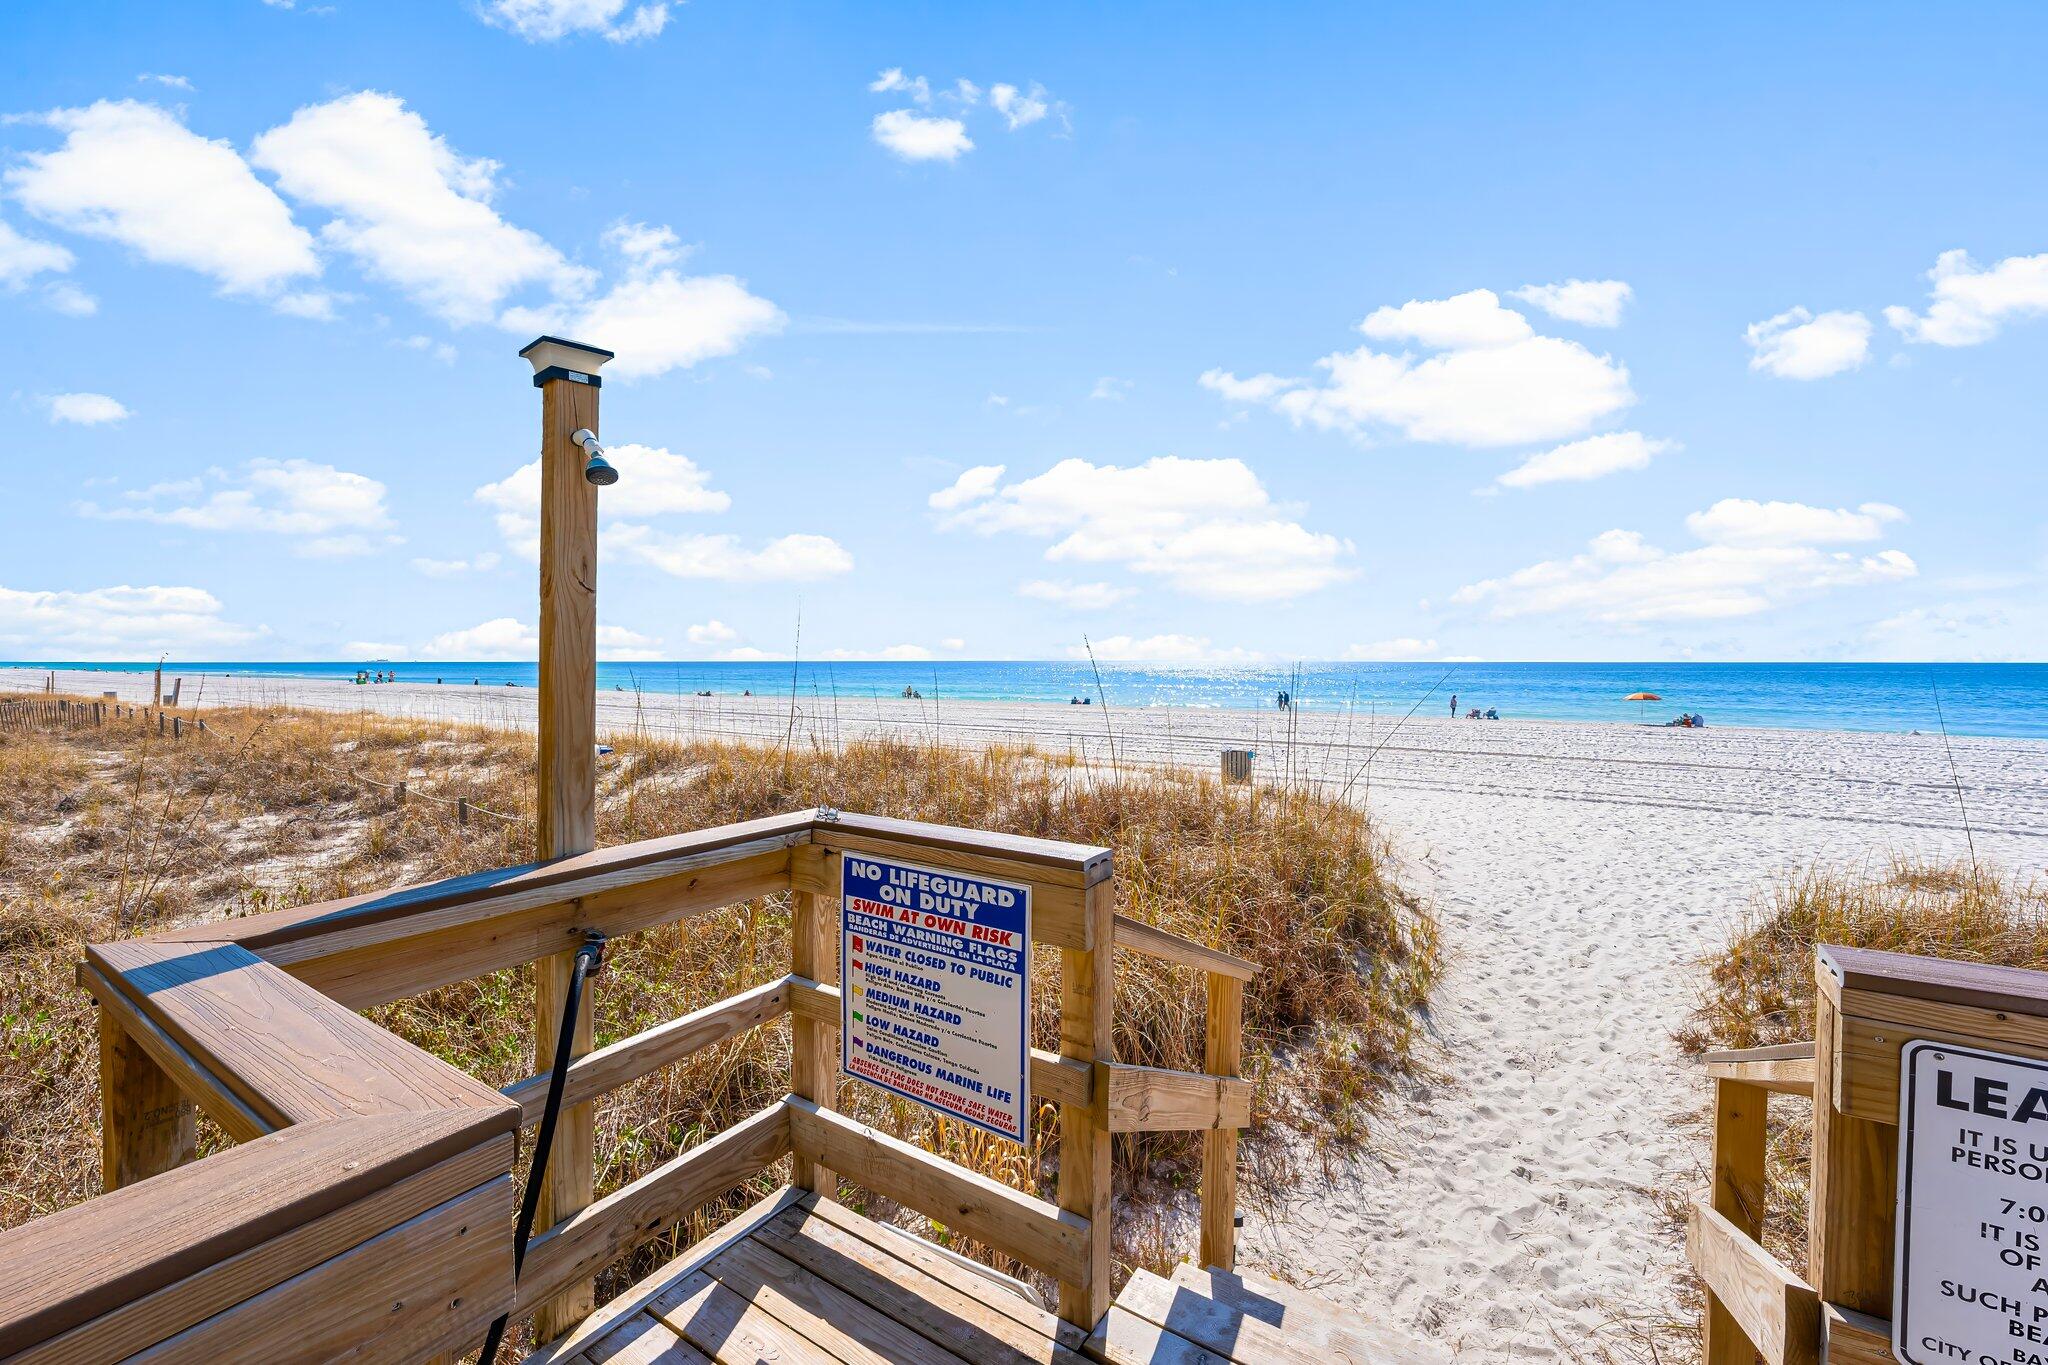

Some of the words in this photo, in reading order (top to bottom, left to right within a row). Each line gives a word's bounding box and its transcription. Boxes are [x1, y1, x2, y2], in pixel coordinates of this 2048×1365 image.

[852, 861, 881, 880] NO
[890, 868, 1015, 908] LIFEGUARD
[880, 885, 910, 905] ON
[920, 893, 979, 919] DUTY
[848, 913, 887, 931] BEACH
[893, 923, 963, 949] WARNING
[970, 942, 1017, 963] FLAGS
[853, 899, 893, 918] SWIM
[899, 909, 919, 924] AT
[925, 915, 966, 935] OWN
[972, 926, 1012, 946] RISK
[849, 924, 887, 938] BANDERAS
[902, 936, 955, 956] ADVERTENSIA
[959, 951, 970, 959] EN
[972, 954, 983, 963] LA
[987, 958, 1015, 970] PLAYA
[866, 941, 900, 958] WATER
[905, 951, 946, 970] CLOSED
[950, 963, 965, 975] TO
[970, 968, 1012, 988] PUBLIC
[865, 962, 890, 979] HIGH
[894, 973, 940, 992] HAZARD
[907, 984, 923, 994] Strong
[866, 988, 909, 1009] MEDIUM
[914, 1002, 962, 1025] HAZARD
[866, 1015, 890, 1030] LOW
[893, 1024, 939, 1047] HAZARD
[852, 1057, 879, 1072] ABSENCE
[890, 1071, 905, 1082] FLAG
[907, 1077, 924, 1088] DOES
[926, 1084, 939, 1094] NOT
[940, 1090, 966, 1105] ASSURE
[968, 1101, 986, 1112] SAFE
[988, 1108, 1012, 1123] WATER
[866, 1043, 932, 1074] DANGEROUS
[935, 1068, 983, 1094] MARINE
[987, 1086, 1011, 1104] LIFE
[857, 1067, 882, 1080] AUSENCIA
[893, 1080, 923, 1096] BANDERAS
[934, 1097, 962, 1111] ASEGURA
[964, 1108, 985, 1120] AGUAS
[986, 1117, 1017, 1132] SEGURAS
[1960, 1129, 1983, 1147] IT
[1994, 1136, 2017, 1155] IS
[1952, 1147, 2048, 1183] PERSO
[2001, 1198, 2048, 1222] 7:0
[1981, 1222, 2004, 1241] IT
[2016, 1231, 2039, 1251] IS
[2000, 1249, 2040, 1270] OF
[1941, 1280, 2020, 1316] SUCH
[1922, 1337, 1972, 1361] CITY
[2013, 1348, 2048, 1365] BA
